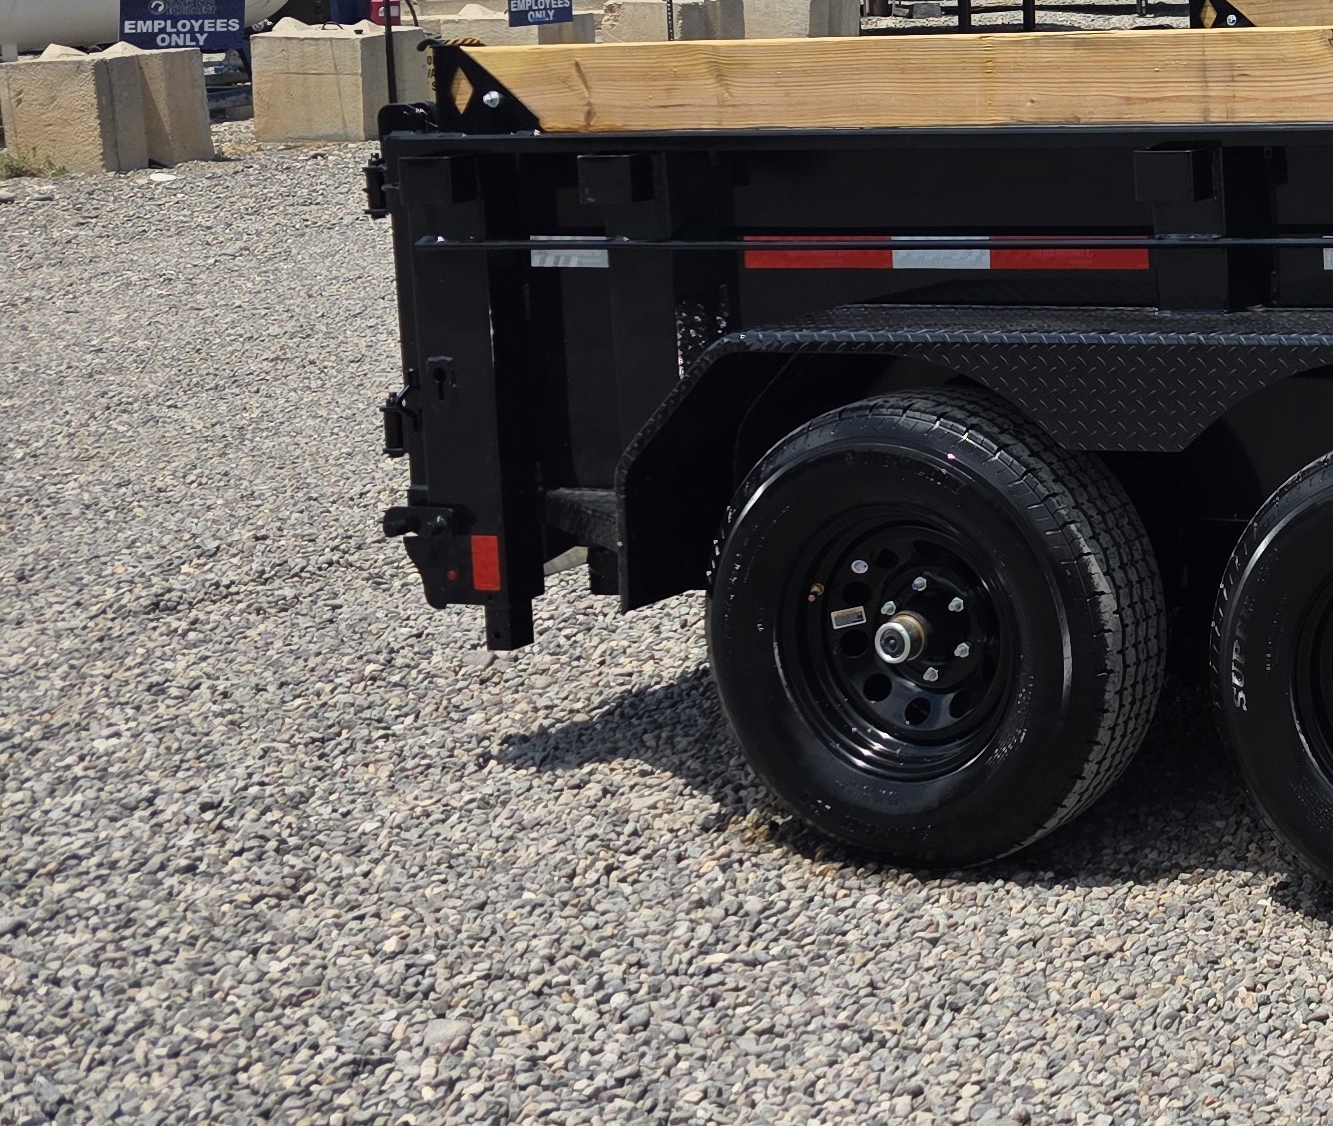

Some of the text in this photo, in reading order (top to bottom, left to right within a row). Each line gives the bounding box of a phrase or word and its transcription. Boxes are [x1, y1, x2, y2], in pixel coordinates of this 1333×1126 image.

[528, 9, 555, 22] ONLY
[124, 18, 240, 33] EMPLOYEES
[156, 33, 208, 46] ONLY
